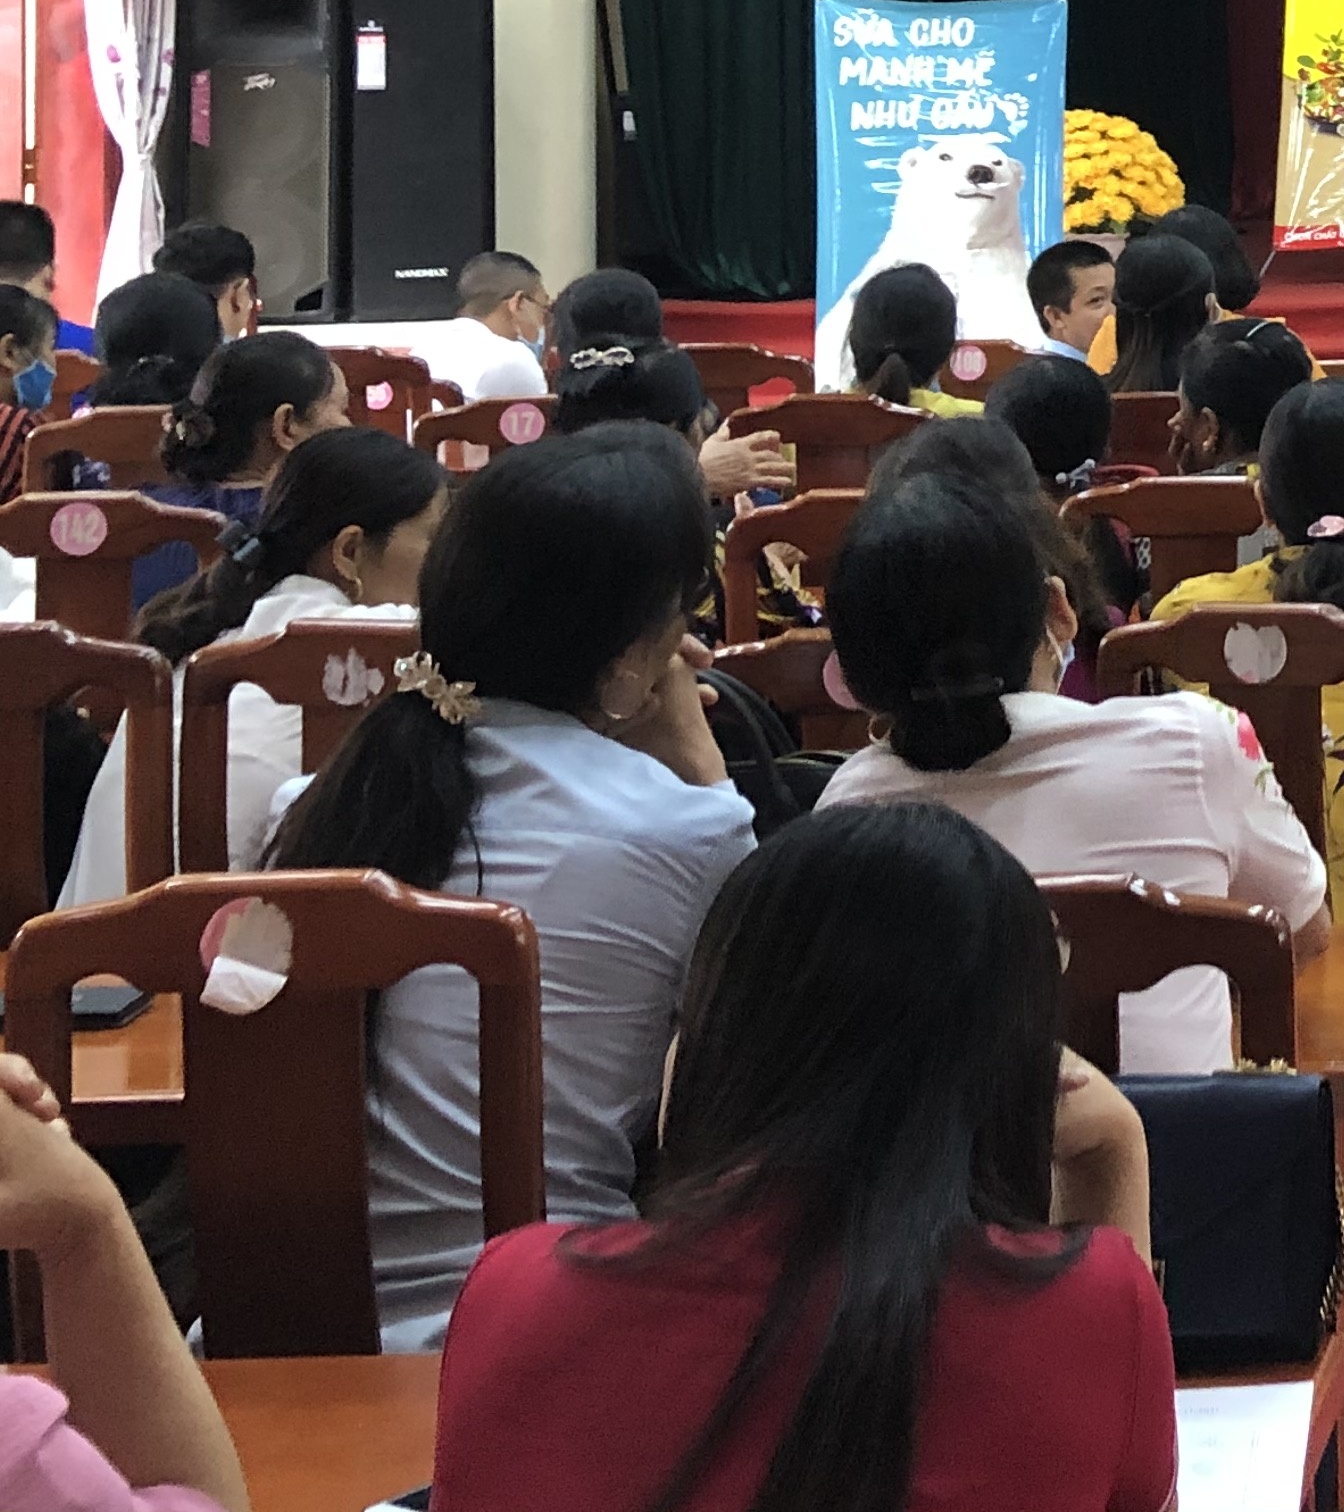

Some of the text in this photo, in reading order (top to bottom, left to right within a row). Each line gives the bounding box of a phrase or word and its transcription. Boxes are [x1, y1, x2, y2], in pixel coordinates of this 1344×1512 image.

[909, 17, 975, 47] CHO
[508, 411, 535, 436] 17
[57, 512, 100, 545] 142
